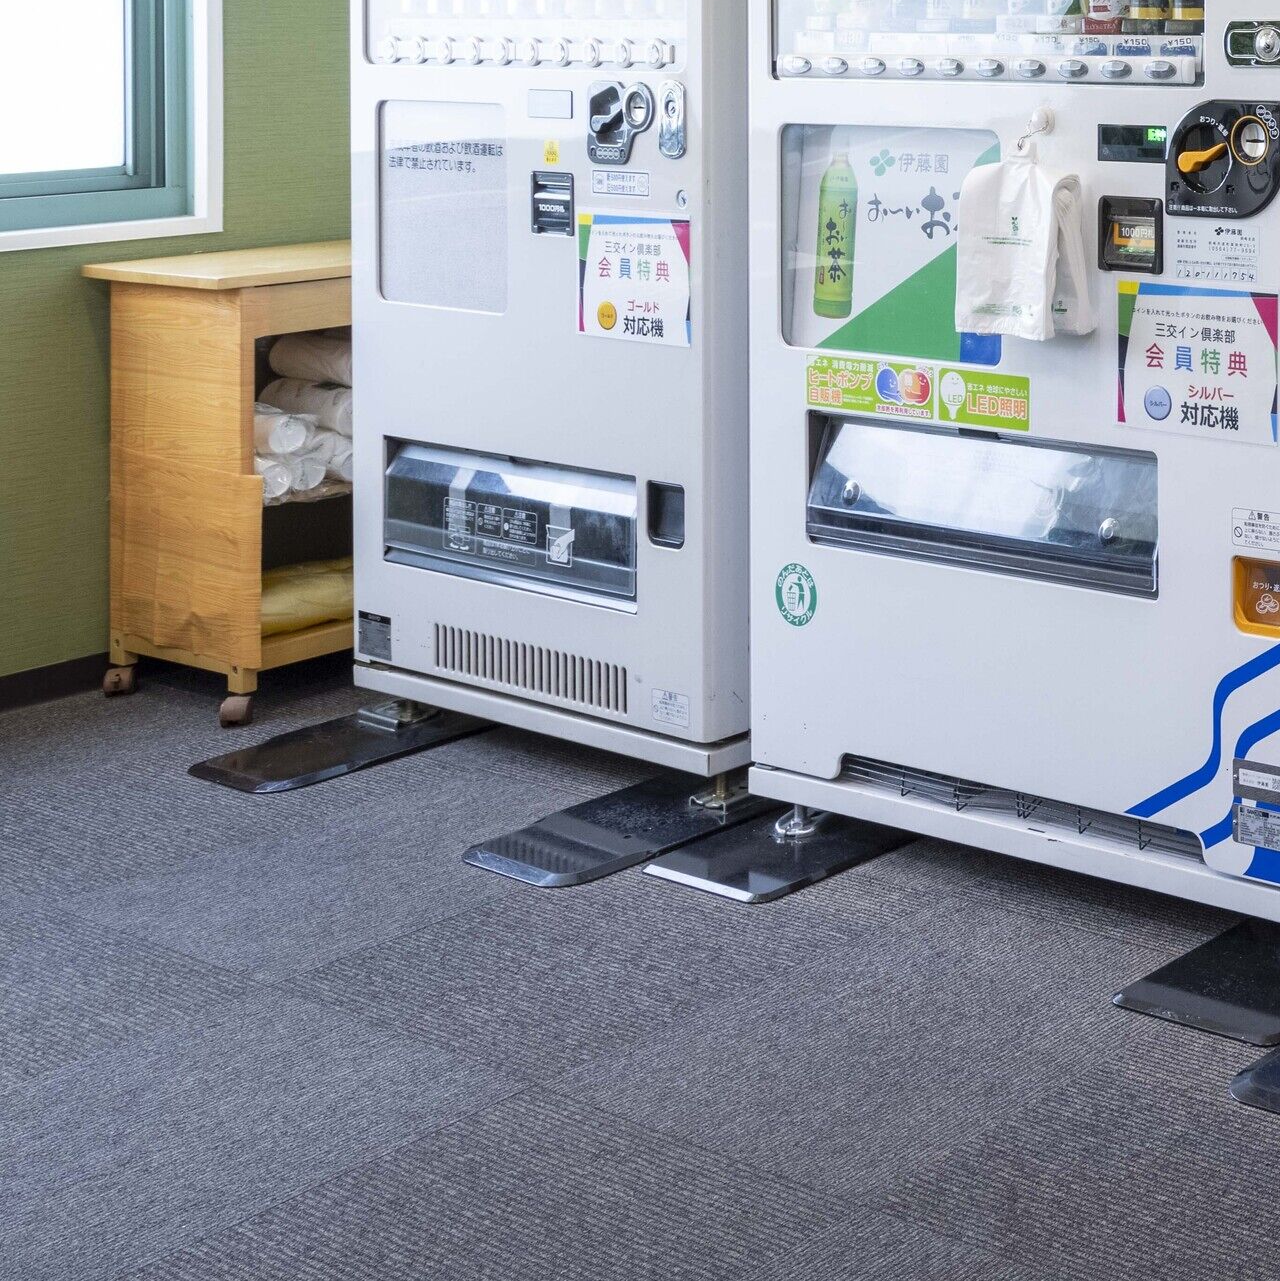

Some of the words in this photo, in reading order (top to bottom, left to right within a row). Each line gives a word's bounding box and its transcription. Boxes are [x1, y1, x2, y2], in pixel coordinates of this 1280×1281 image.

[898, 152, 949, 174] 伊藤園
[605, 242, 661, 257] 三交イン倶楽部
[598, 257, 670, 282] 会員特典
[628, 300, 660, 314] ゴールド
[623, 316, 664, 338] 対応機
[1155, 322, 1236, 344] 三交イン倶楽部
[1146, 343, 1248, 378] 会員特典
[808, 370, 873, 389] ヒートポンプ
[809, 388, 842, 404] 自販機
[948, 394, 962, 403] LED
[1188, 385, 1234, 401] シルバー
[967, 393, 1027, 418] LED照明
[1181, 402, 1239, 431] 対応機
